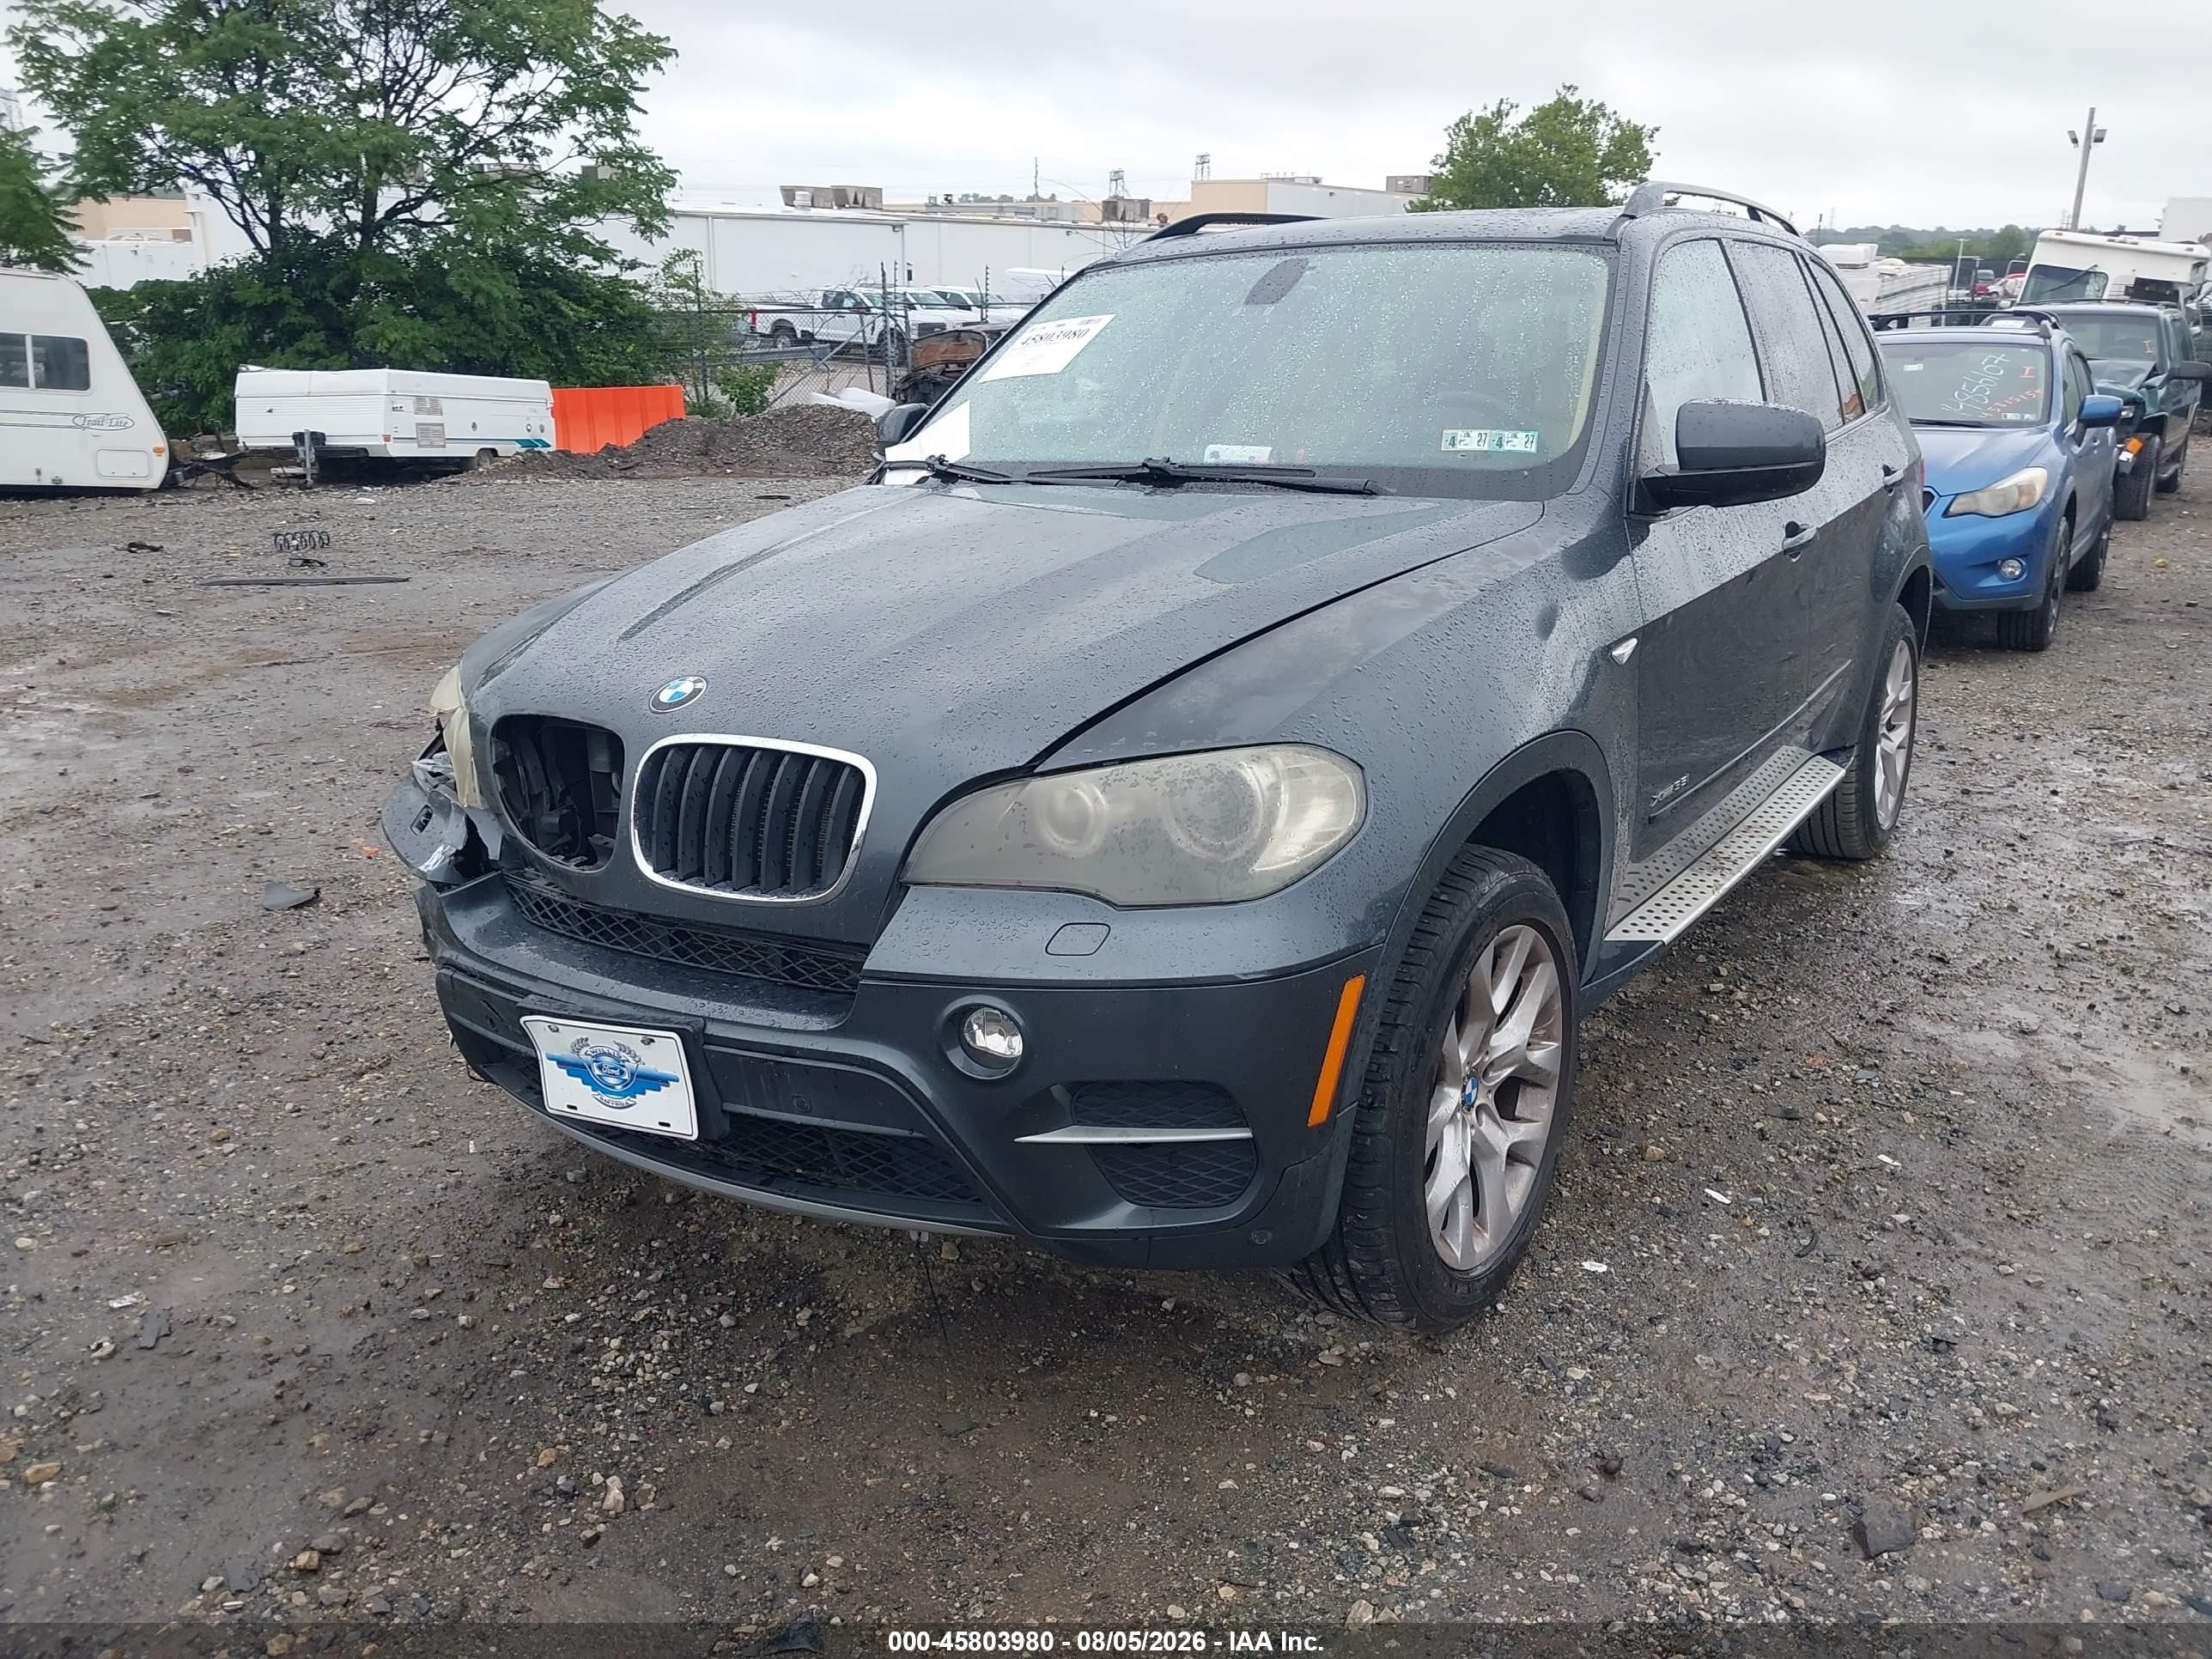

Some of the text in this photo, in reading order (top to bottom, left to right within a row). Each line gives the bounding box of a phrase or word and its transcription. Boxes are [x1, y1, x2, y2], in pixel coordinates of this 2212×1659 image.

[1477, 432, 1488, 447] 27
[1524, 434, 1535, 450] 27
[601, 1064, 620, 1076] Ford
